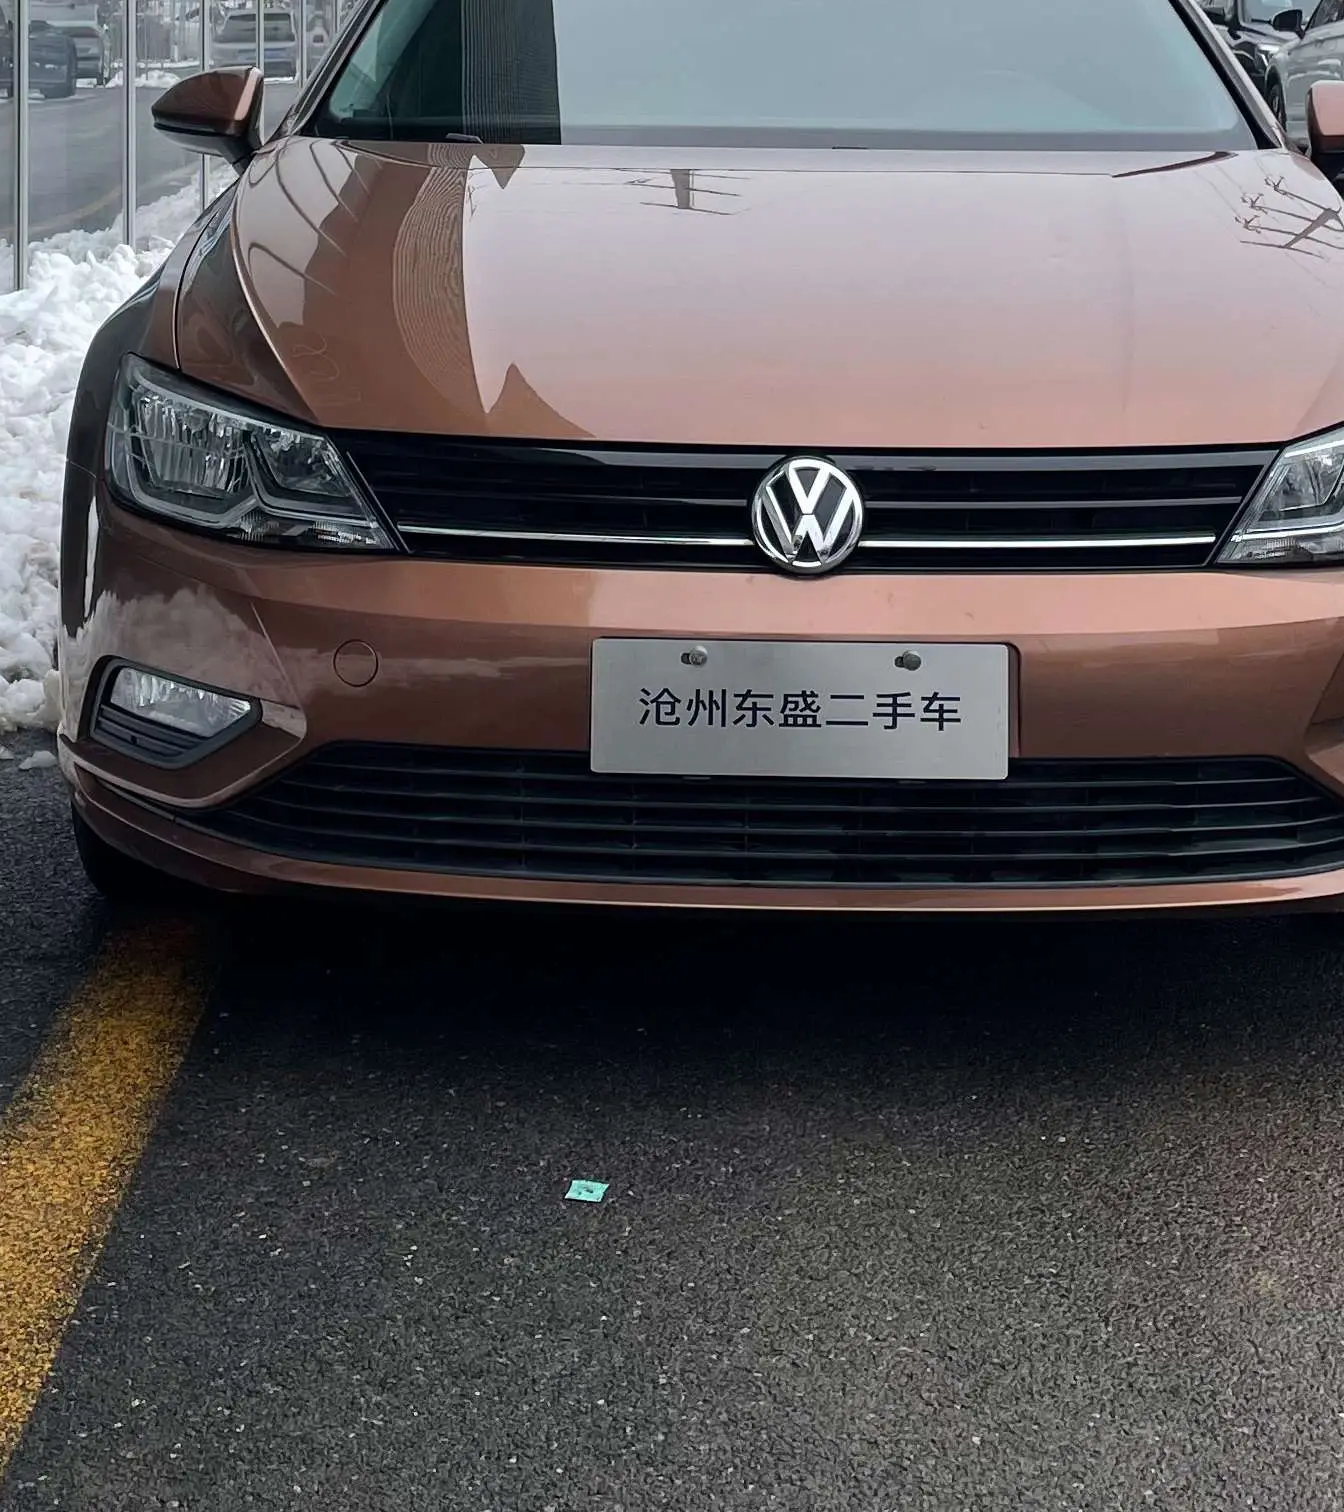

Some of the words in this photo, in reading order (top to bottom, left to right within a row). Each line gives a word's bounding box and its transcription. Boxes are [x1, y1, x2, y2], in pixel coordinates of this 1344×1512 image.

[638, 687, 961, 732] 沧州东盛二手车
